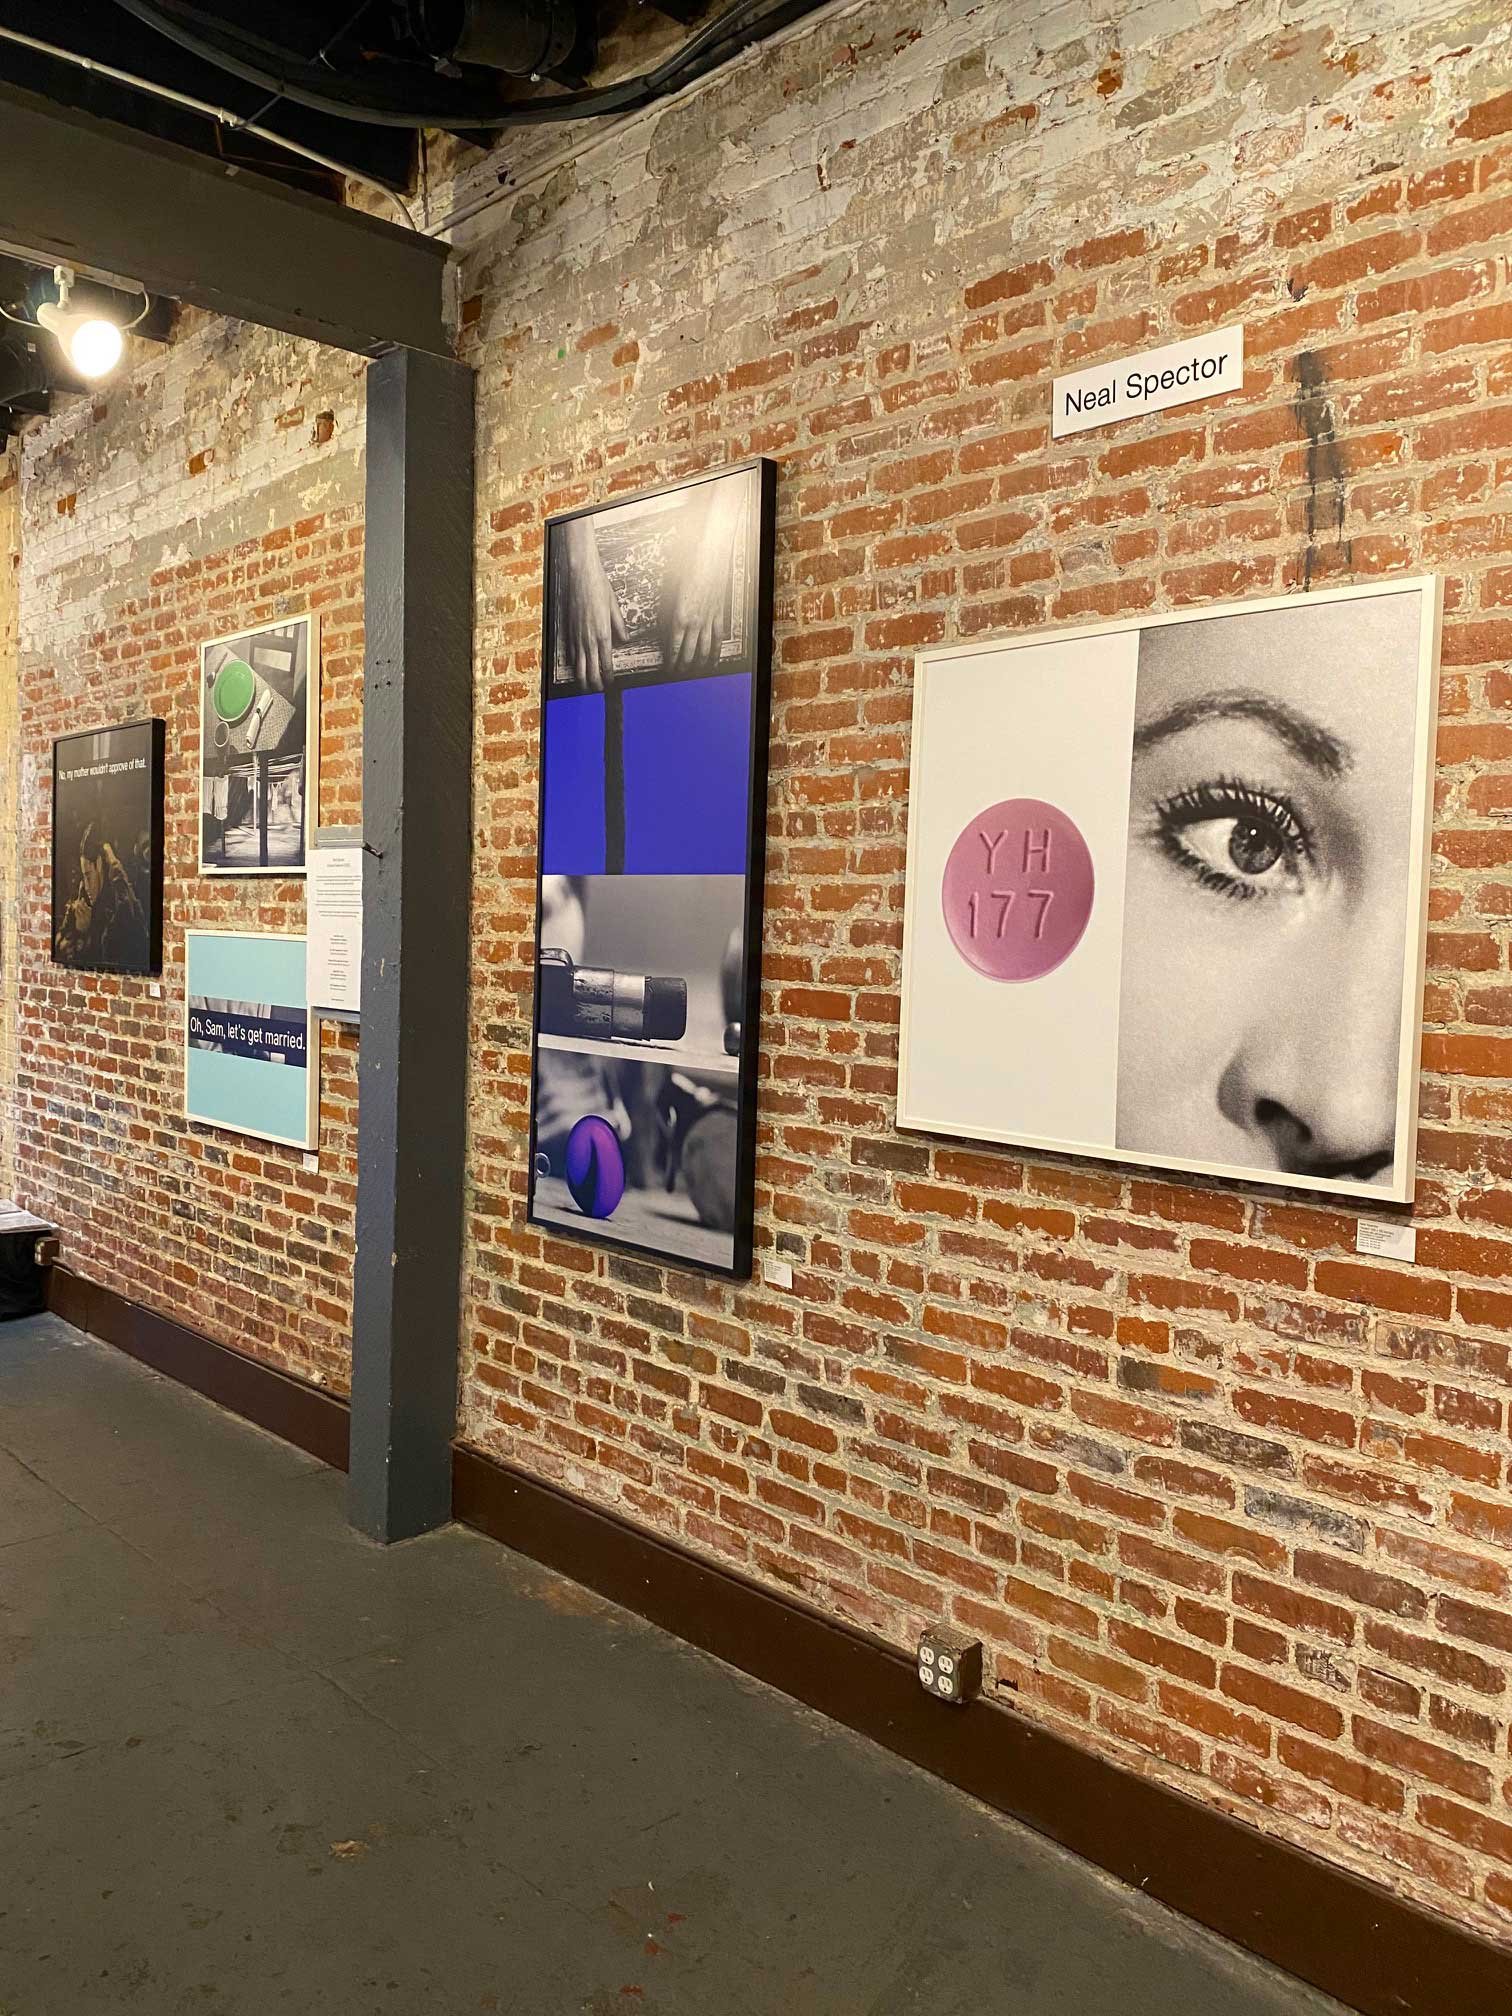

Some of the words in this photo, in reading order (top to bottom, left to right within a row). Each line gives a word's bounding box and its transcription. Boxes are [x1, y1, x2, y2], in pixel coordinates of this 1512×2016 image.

[1065, 379, 1116, 416] Neal
[1126, 353, 1228, 400] Spector
[67, 770, 73, 781] my
[74, 767, 89, 778] mother
[89, 763, 108, 775] wouldn't
[108, 761, 128, 775] approve
[128, 759, 134, 770] of
[968, 888, 1054, 939] 177
[190, 1016, 204, 1036] Oh,
[205, 1018, 226, 1039] Sam,
[227, 1022, 246, 1040] let's
[247, 1028, 263, 1046] get
[265, 1030, 306, 1050] married.
